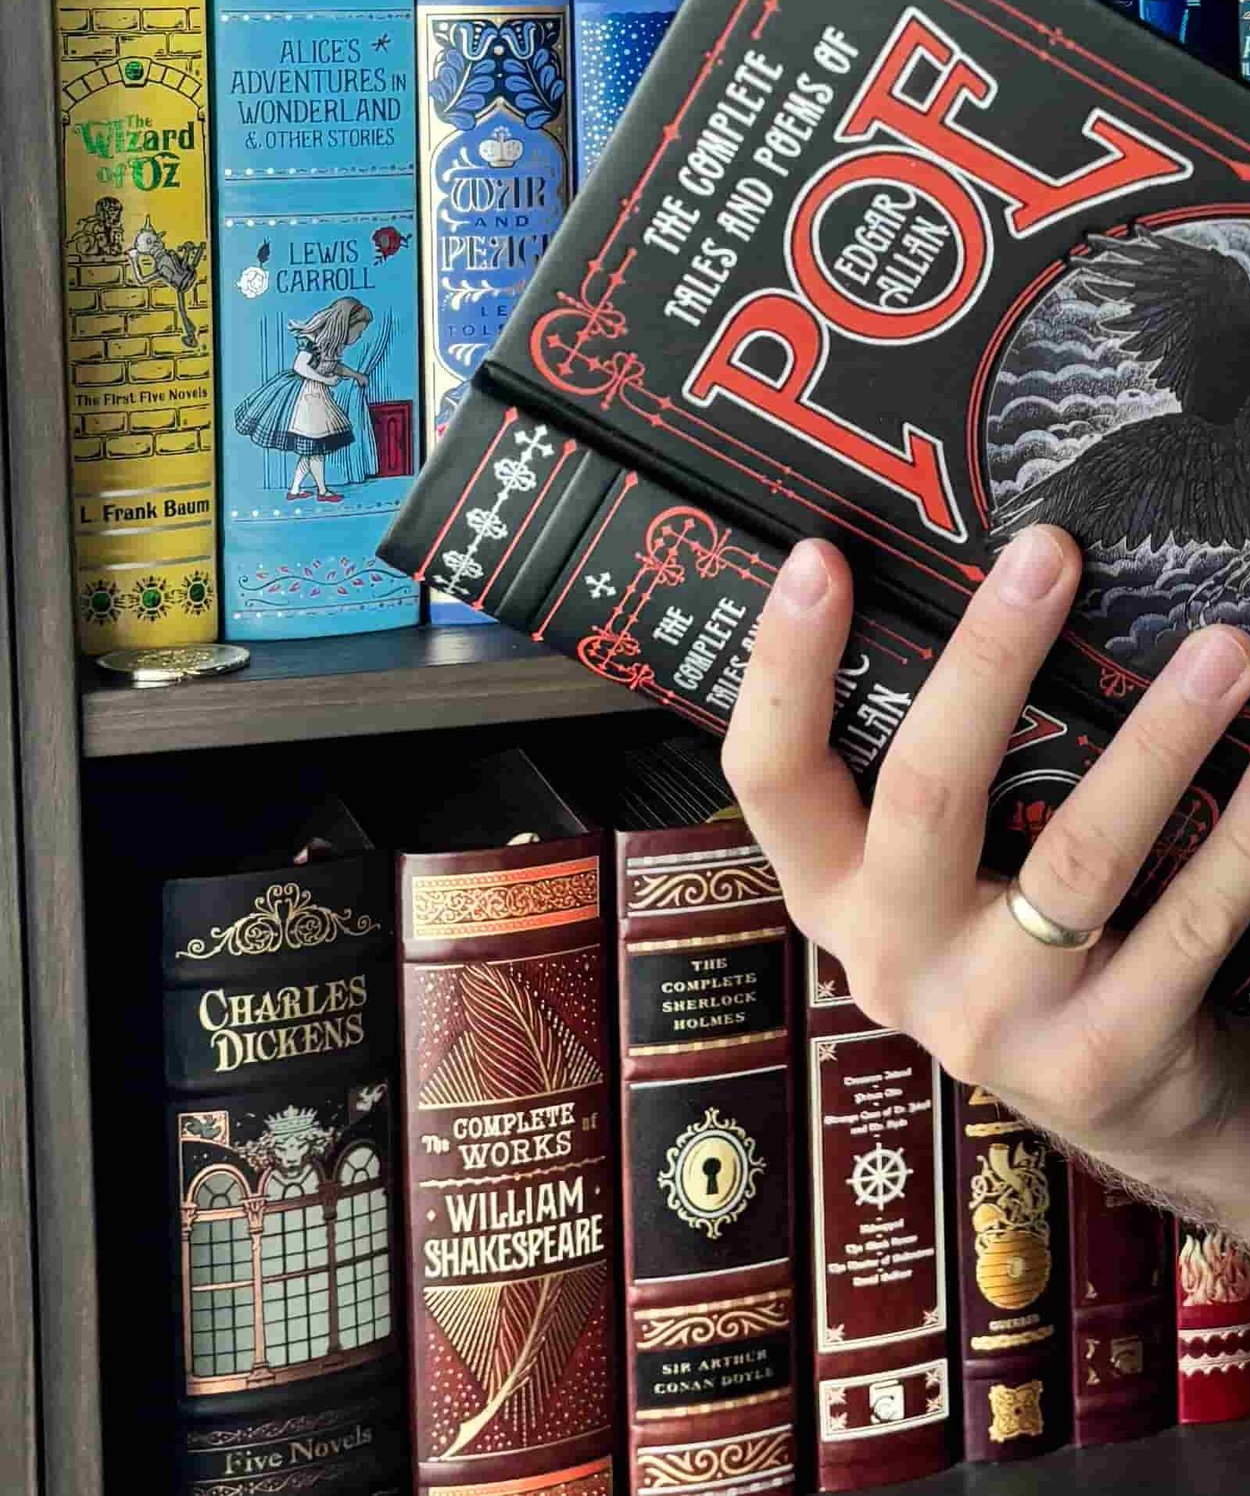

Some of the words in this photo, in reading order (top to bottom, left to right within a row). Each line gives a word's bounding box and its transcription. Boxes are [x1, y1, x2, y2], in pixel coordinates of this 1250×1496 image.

[280, 38, 361, 64] ALICE'S
[230, 67, 386, 94] ADVENTURES
[391, 73, 407, 92] IN
[125, 114, 153, 127] The
[237, 97, 401, 124] WONDERLAND
[74, 119, 195, 159] Wizard
[266, 130, 323, 148] OTHER
[328, 127, 395, 147] STORIES
[644, 196, 701, 255] THE
[678, 50, 784, 196] COMPLETE
[96, 163, 126, 188] of
[127, 152, 180, 191] Oz
[664, 237, 738, 327] TALES
[716, 177, 774, 242] AND
[753, 72, 834, 177] POEMS
[813, 25, 859, 74] OF
[451, 176, 546, 212] WAR
[474, 215, 529, 227] AND
[834, 188, 917, 286] EDGAR
[290, 239, 359, 265] LEWIS
[440, 233, 550, 271] PEAC
[876, 215, 950, 307] ALLAN
[276, 267, 376, 293] CARROLL
[682, 6, 1195, 544] POE
[481, 305, 515, 317] LE
[75, 394, 97, 406] The
[104, 392, 136, 406] First
[140, 391, 164, 403] Five
[169, 387, 207, 400] Novels
[103, 502, 157, 522] Frank
[164, 499, 209, 517] Baum
[651, 605, 694, 646] THE
[673, 595, 747, 691] COMPLETE
[691, 957, 728, 972] THE
[661, 972, 758, 994] COMPLETE
[199, 974, 368, 1032] CHARLES
[662, 990, 757, 1013] SHERLOCK
[673, 1011, 746, 1031] HOLMES
[210, 1012, 365, 1073] DICKENS
[421, 1135, 450, 1154] The
[453, 1102, 576, 1139] COMPLETE
[458, 1130, 572, 1170] WORKS
[444, 1176, 584, 1233] WILLIAM
[424, 1214, 605, 1279] SHAKESPEARE
[662, 1361, 692, 1375] SIR
[698, 1349, 767, 1372] ARTHUR
[654, 1378, 714, 1395] CONAN
[721, 1368, 774, 1387] DOYLE
[224, 1451, 283, 1474] Five
[289, 1424, 373, 1462] Novels
